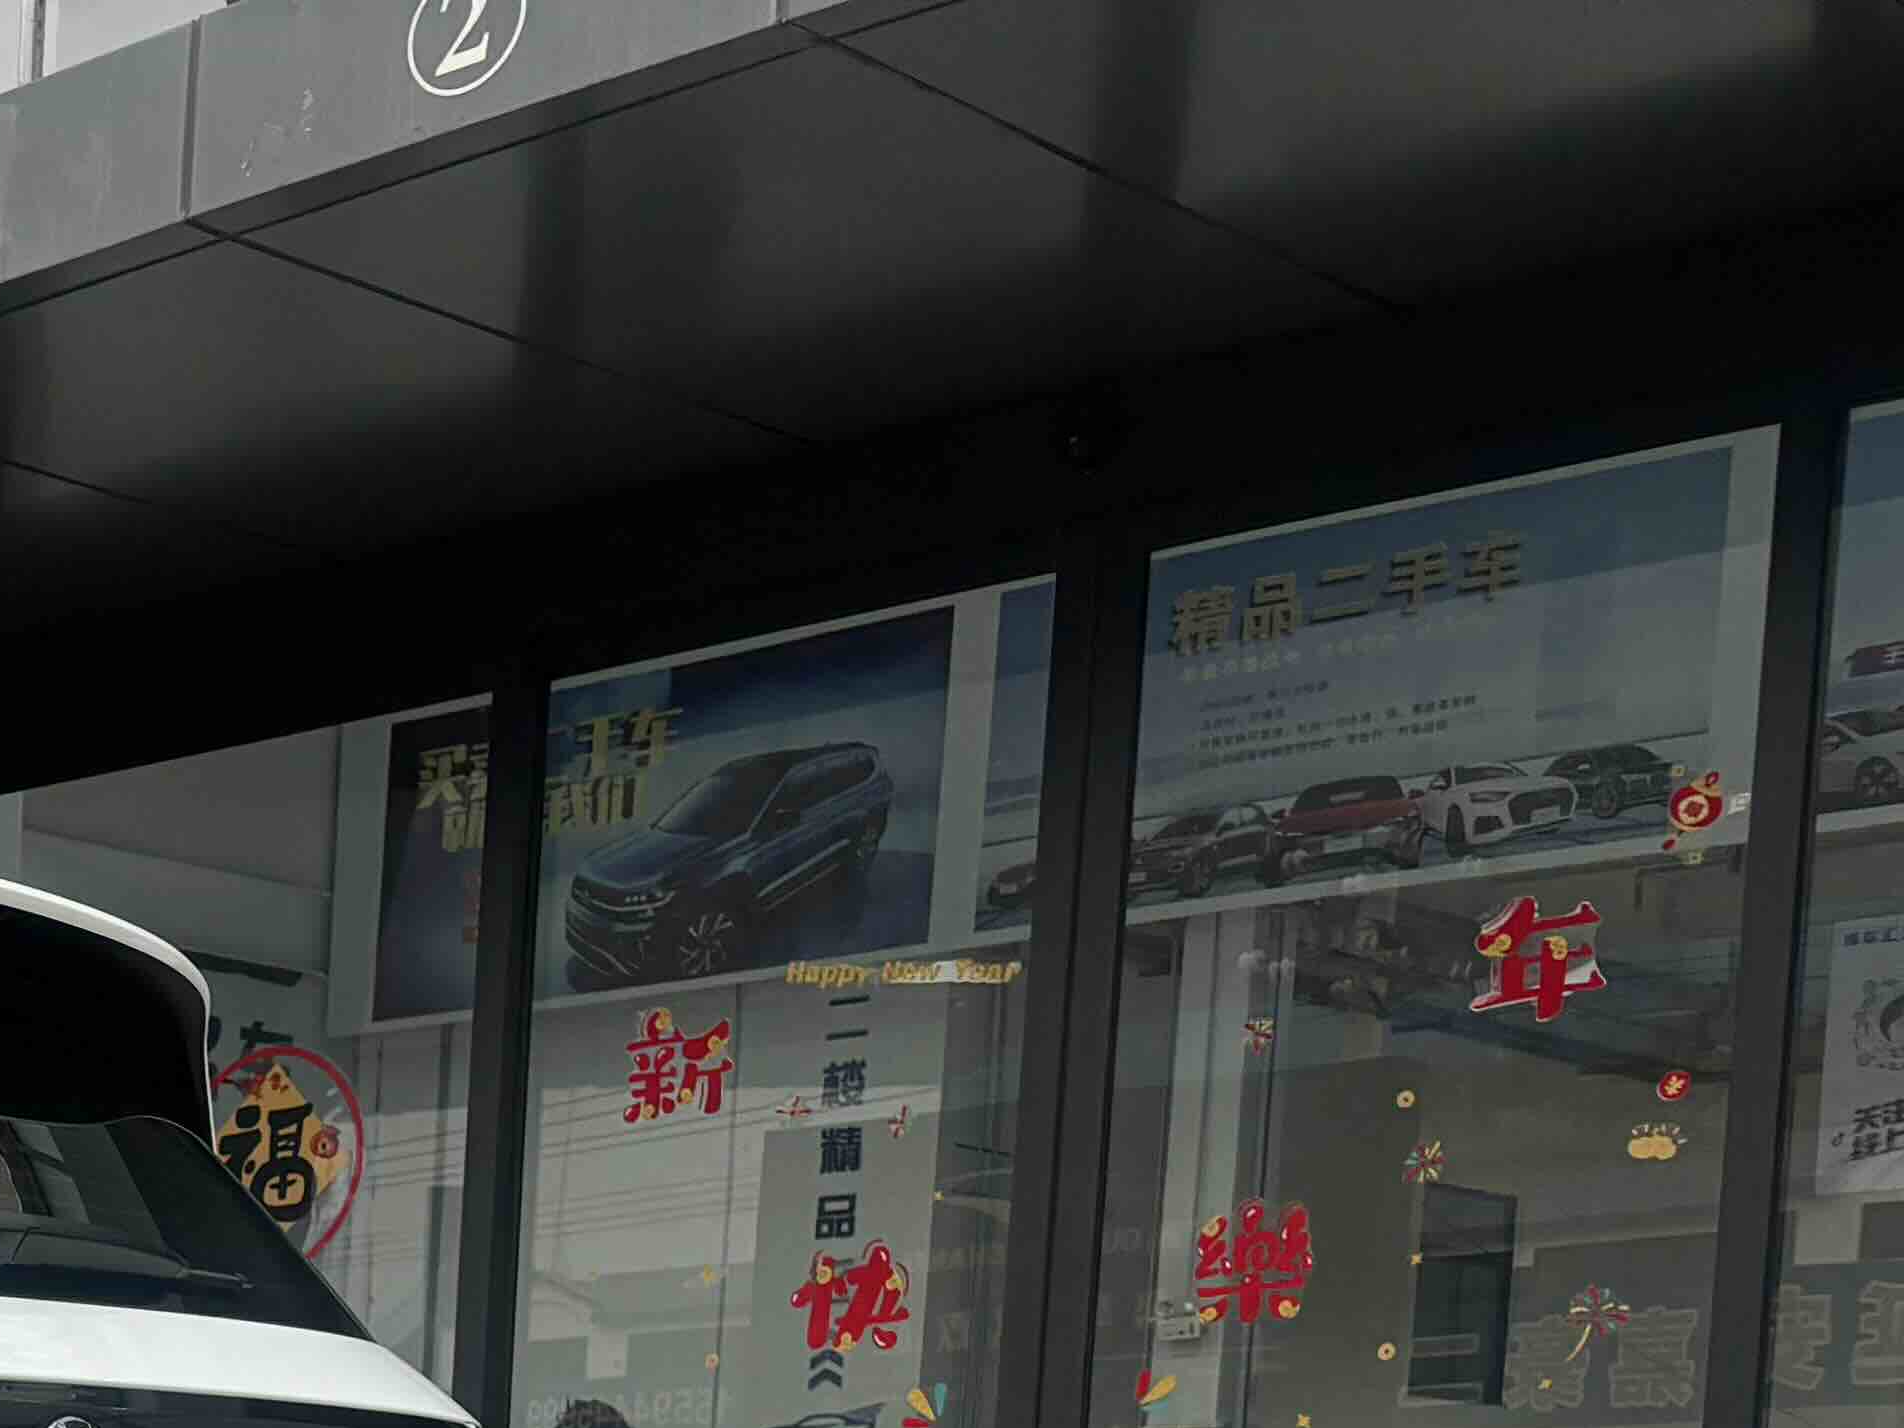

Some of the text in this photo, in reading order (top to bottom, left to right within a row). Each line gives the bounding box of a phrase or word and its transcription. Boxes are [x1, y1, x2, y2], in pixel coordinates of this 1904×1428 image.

[1166, 530, 1526, 656] 精品二手车
[785, 959, 873, 990] Happy
[1470, 895, 1608, 1024] 年
[623, 1006, 734, 1126] 新
[790, 1240, 916, 1352] 快
